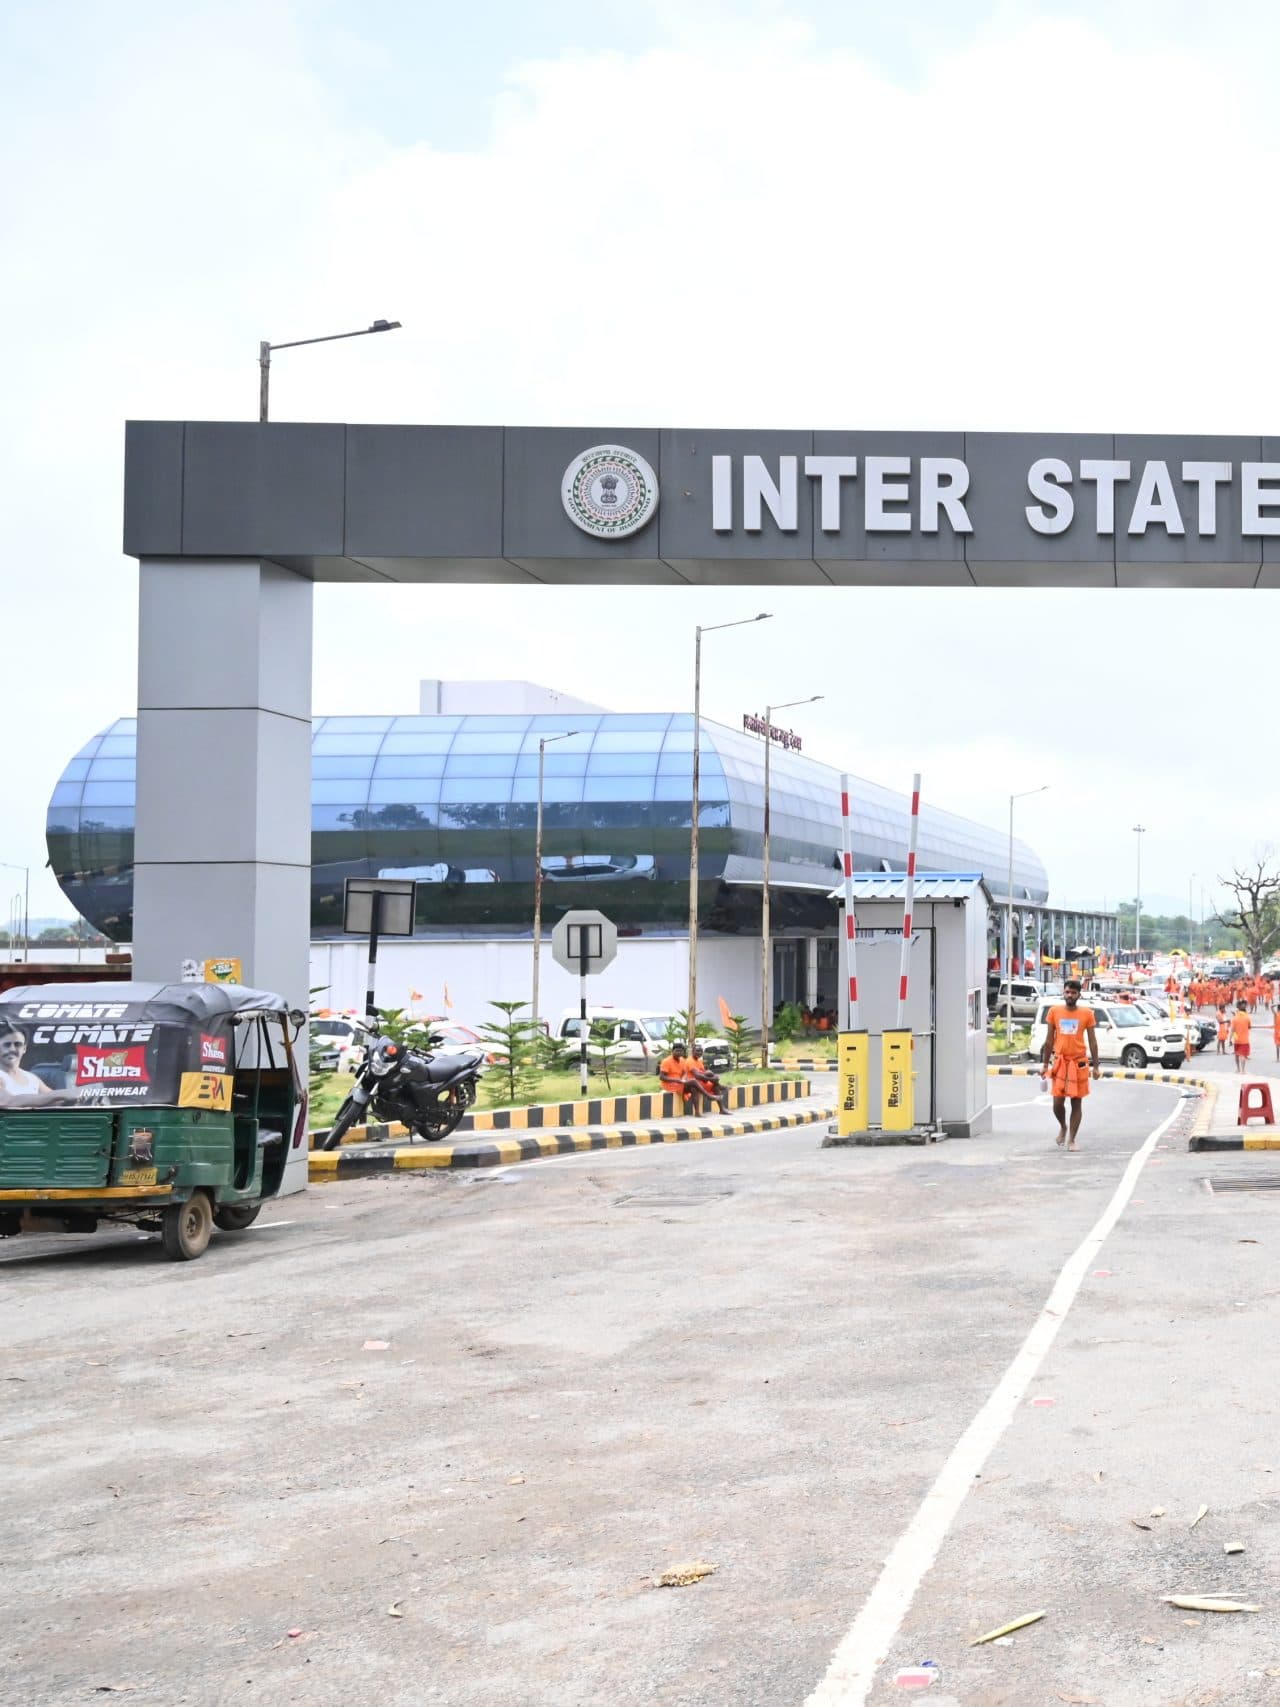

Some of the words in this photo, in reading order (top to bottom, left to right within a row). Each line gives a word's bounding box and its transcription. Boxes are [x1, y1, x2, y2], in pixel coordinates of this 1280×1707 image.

[711, 453, 975, 534] INTER
[18, 1003, 129, 1019] COMATE
[32, 1023, 156, 1044] COMATE
[80, 1056, 142, 1078] Shera
[79, 1086, 149, 1098] INNERWEAR
[198, 1076, 225, 1101] ERA
